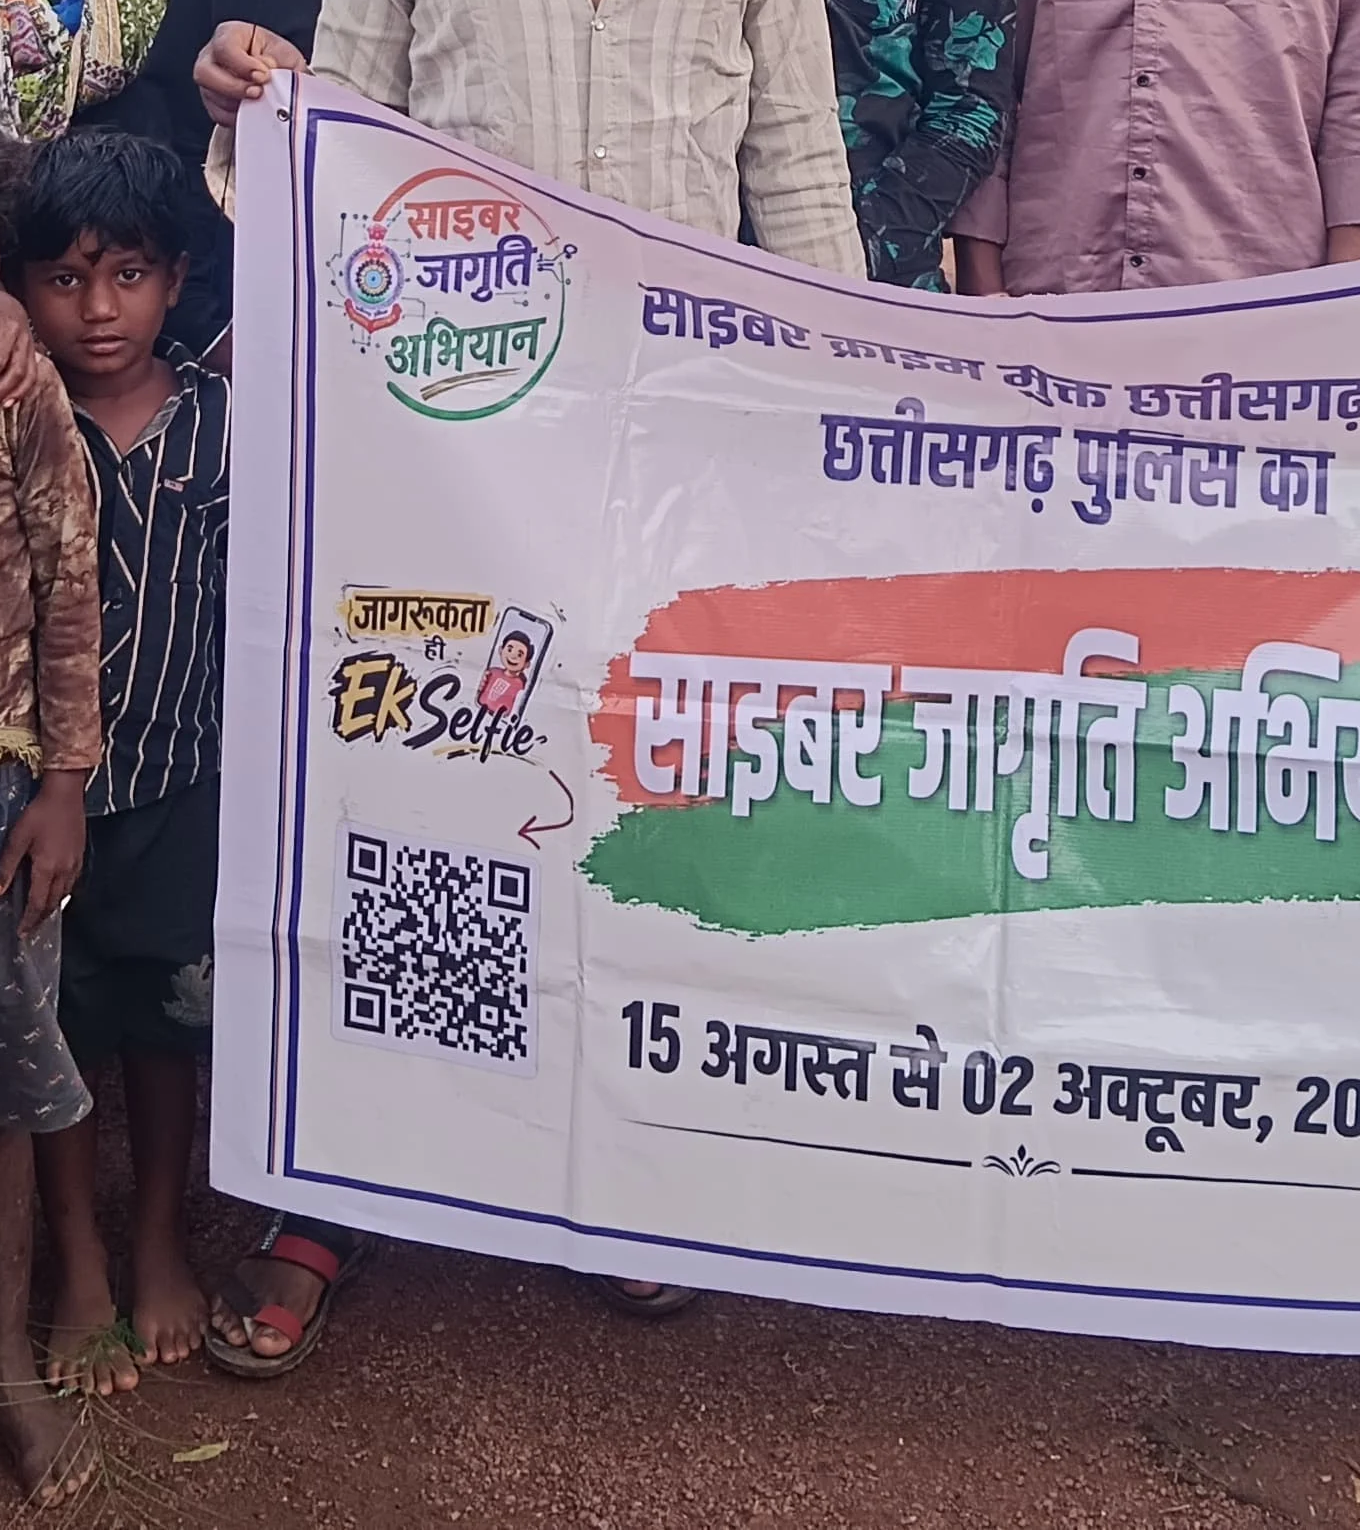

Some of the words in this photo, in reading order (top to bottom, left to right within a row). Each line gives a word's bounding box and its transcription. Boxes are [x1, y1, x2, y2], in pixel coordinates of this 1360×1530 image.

[404, 199, 522, 242] साइबर
[414, 234, 538, 302] जागृति
[385, 316, 548, 378] अभियान
[638, 282, 811, 349] साइबर
[821, 333, 985, 380] क्राइम
[996, 364, 1112, 407] मुक्त
[820, 397, 1062, 513] छत्तीसगढ़
[1071, 428, 1245, 526] पुलिस
[1256, 446, 1336, 516] का
[354, 595, 490, 633] जागरूकता
[424, 634, 447, 660] ही
[402, 673, 535, 763] Selfie
[628, 651, 894, 817] साइबर
[901, 628, 1148, 880] जागृति
[620, 999, 682, 1074] 15
[700, 1020, 877, 1103] अगस्त
[889, 1024, 947, 1111] से
[961, 1049, 1035, 1117] 02
[1051, 1059, 1275, 1153] अक्टूबर,
